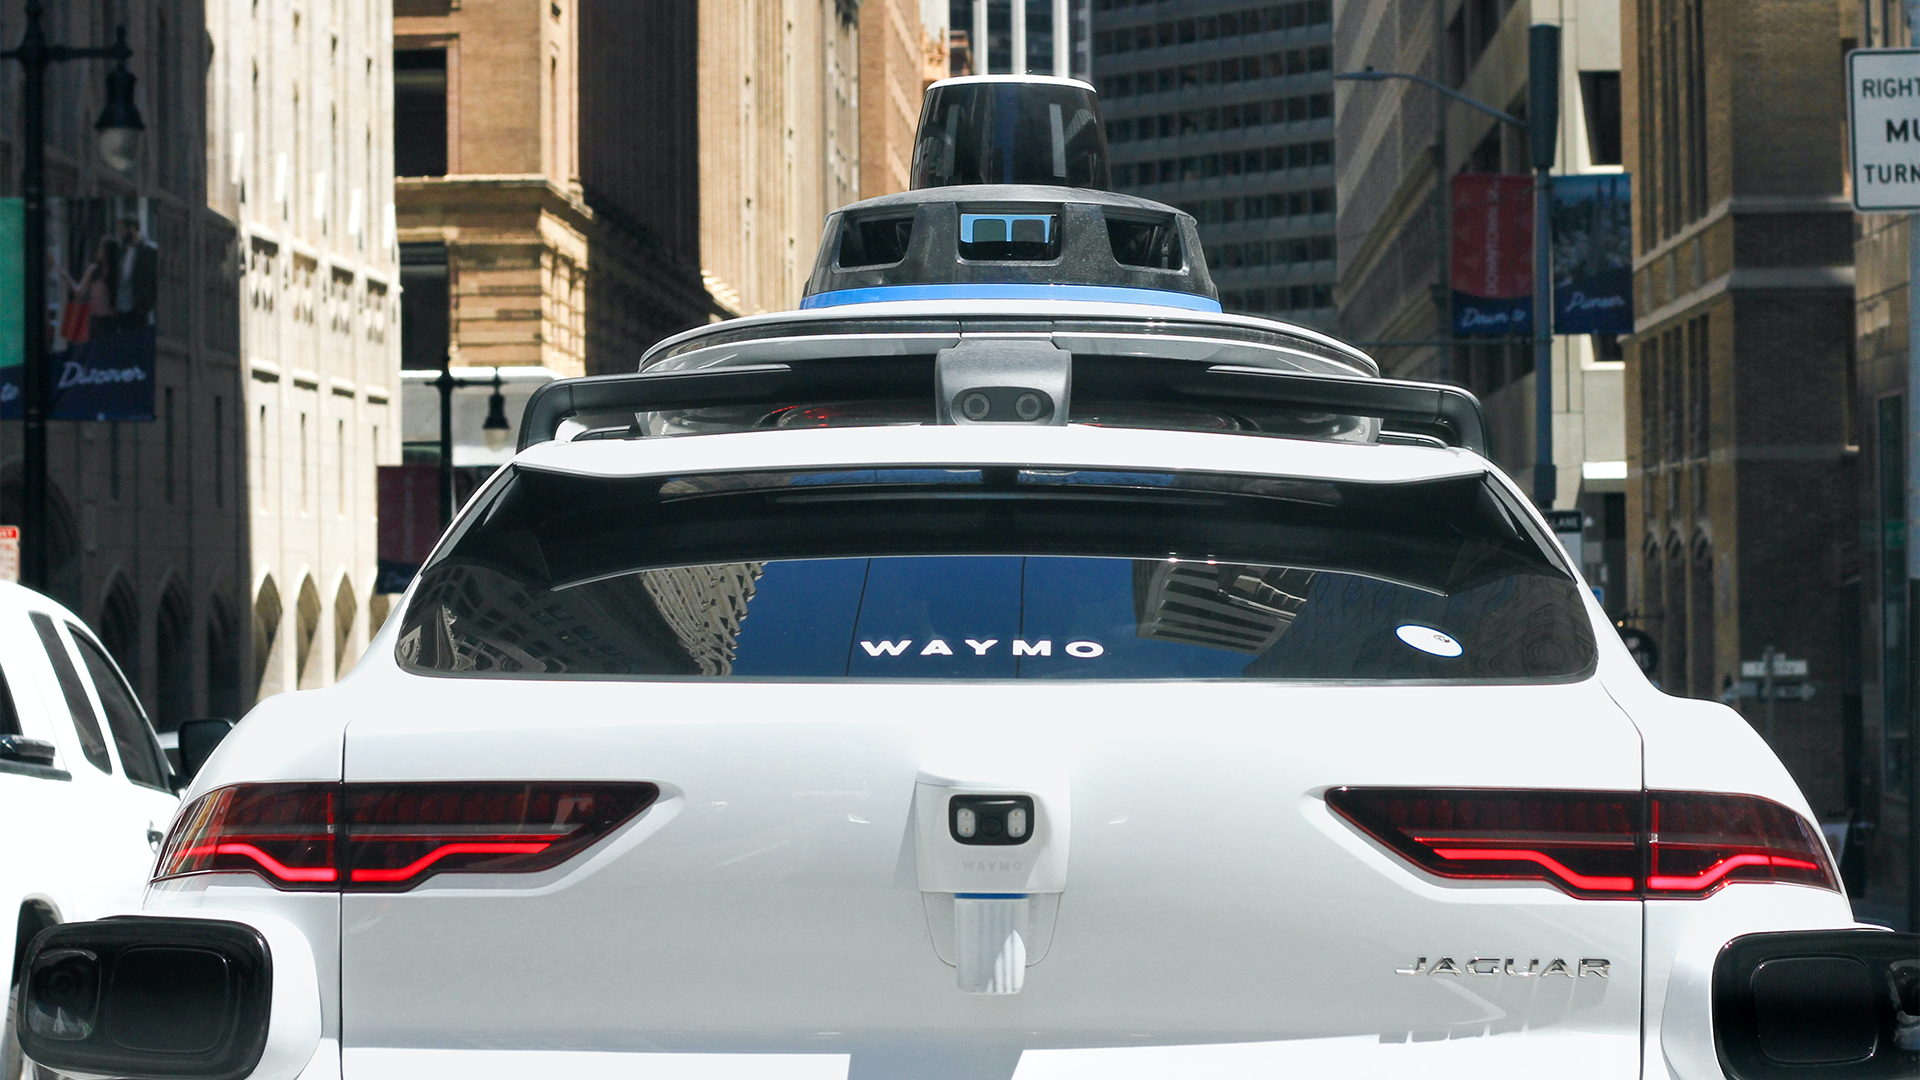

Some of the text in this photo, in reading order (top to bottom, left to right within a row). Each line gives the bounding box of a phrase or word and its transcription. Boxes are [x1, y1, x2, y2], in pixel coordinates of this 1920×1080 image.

[1862, 78, 1920, 98] RIGHT
[1864, 164, 1920, 184] TURN
[1461, 308, 1508, 327] Down
[58, 361, 147, 389] Discover
[860, 639, 1104, 658] WAYMO
[962, 860, 1023, 873] WAYMO
[1394, 955, 1611, 979] JAGUAR
